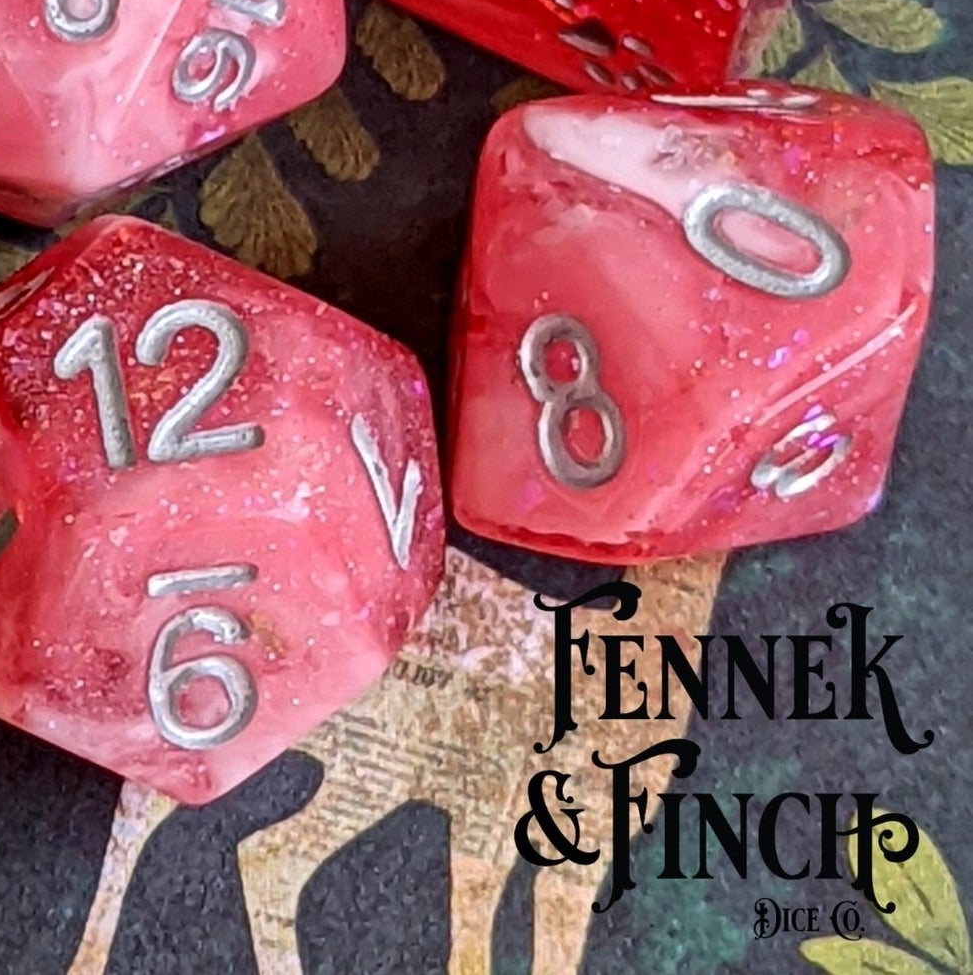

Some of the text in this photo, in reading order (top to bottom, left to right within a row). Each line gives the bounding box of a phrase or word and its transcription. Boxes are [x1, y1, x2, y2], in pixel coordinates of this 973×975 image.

[683, 181, 851, 300] 0
[53, 298, 265, 469] 12
[518, 313, 624, 490] 8
